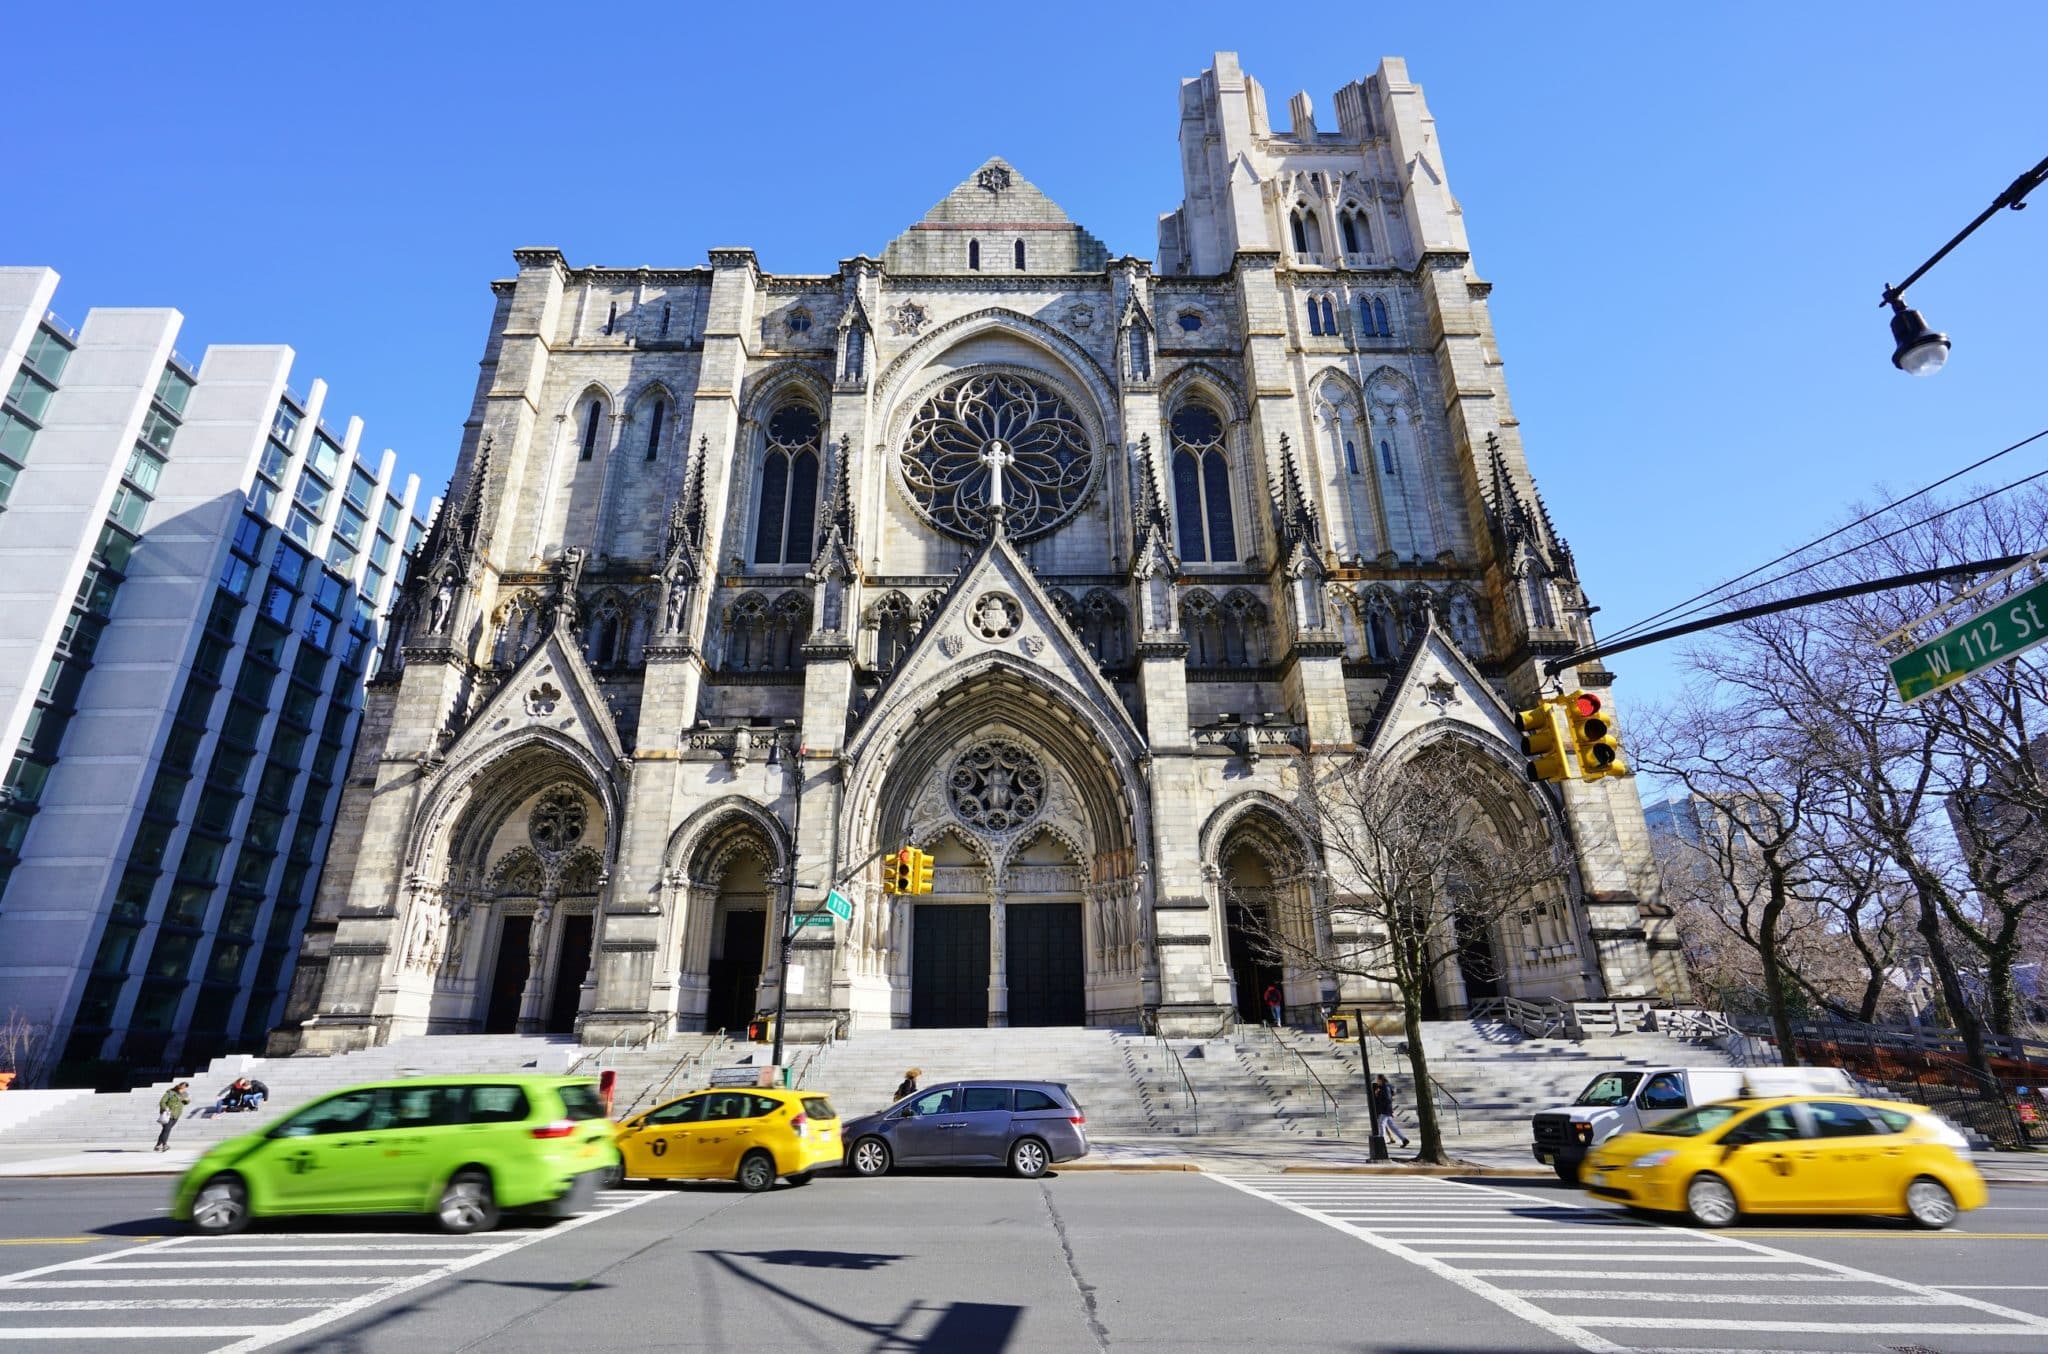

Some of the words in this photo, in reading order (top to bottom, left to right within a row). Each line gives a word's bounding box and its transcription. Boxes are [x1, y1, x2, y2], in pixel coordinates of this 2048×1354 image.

[1925, 645, 1952, 679] W
[1959, 621, 2004, 662] 112
[2010, 600, 2045, 639] St
